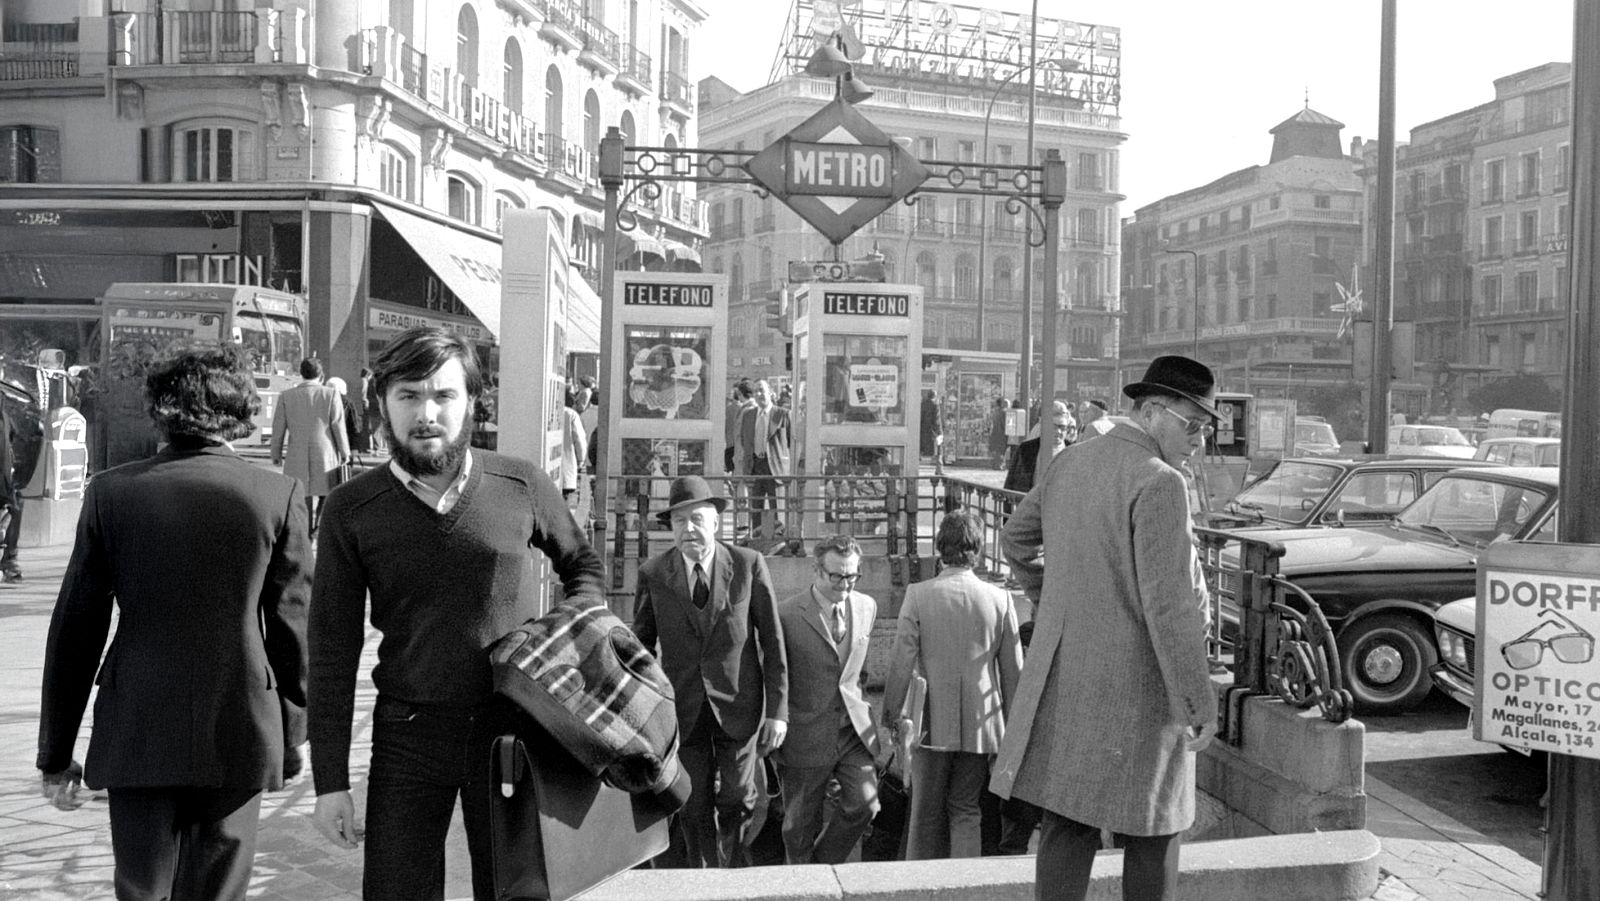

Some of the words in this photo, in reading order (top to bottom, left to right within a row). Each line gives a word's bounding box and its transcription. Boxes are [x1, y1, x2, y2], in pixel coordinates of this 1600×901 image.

[980, 8, 1121, 58] PEPE
[471, 87, 545, 164] PUENTE
[794, 150, 884, 187] METRO
[627, 285, 710, 305] TELEFONO
[827, 295, 907, 314] TELEFONO
[379, 312, 427, 329] PARAGUAS
[1504, 695, 1568, 715] Mayor,
[1575, 703, 1593, 716] 17
[1491, 708, 1582, 732] Magallanes,
[1587, 720, 1600, 733] 2
[1501, 724, 1561, 746] Alcala,
[1565, 733, 1594, 748] 134
